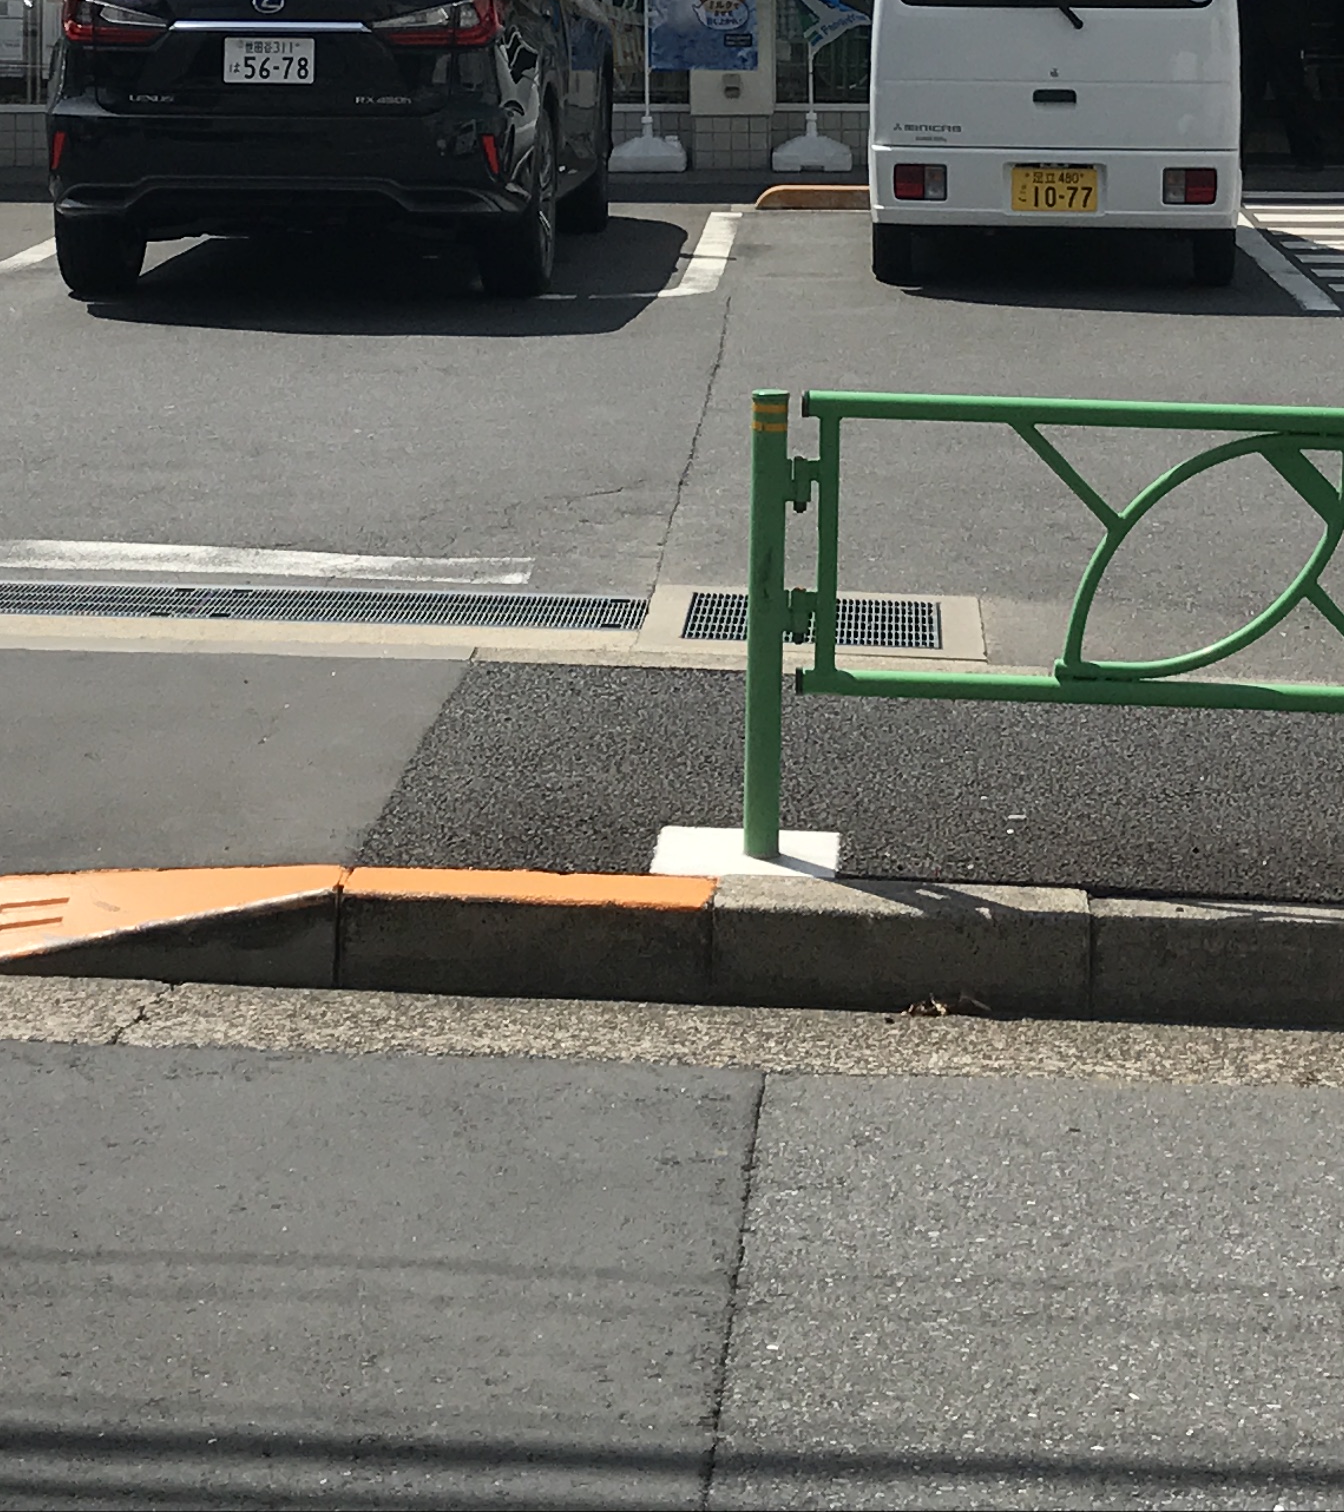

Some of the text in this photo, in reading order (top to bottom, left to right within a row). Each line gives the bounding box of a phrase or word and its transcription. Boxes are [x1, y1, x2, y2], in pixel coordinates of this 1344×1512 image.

[244, 56, 309, 80] 56-78
[904, 124, 962, 133] MINICAB
[1033, 171, 1079, 184] 足立 480
[1034, 186, 1093, 208] 10-77
